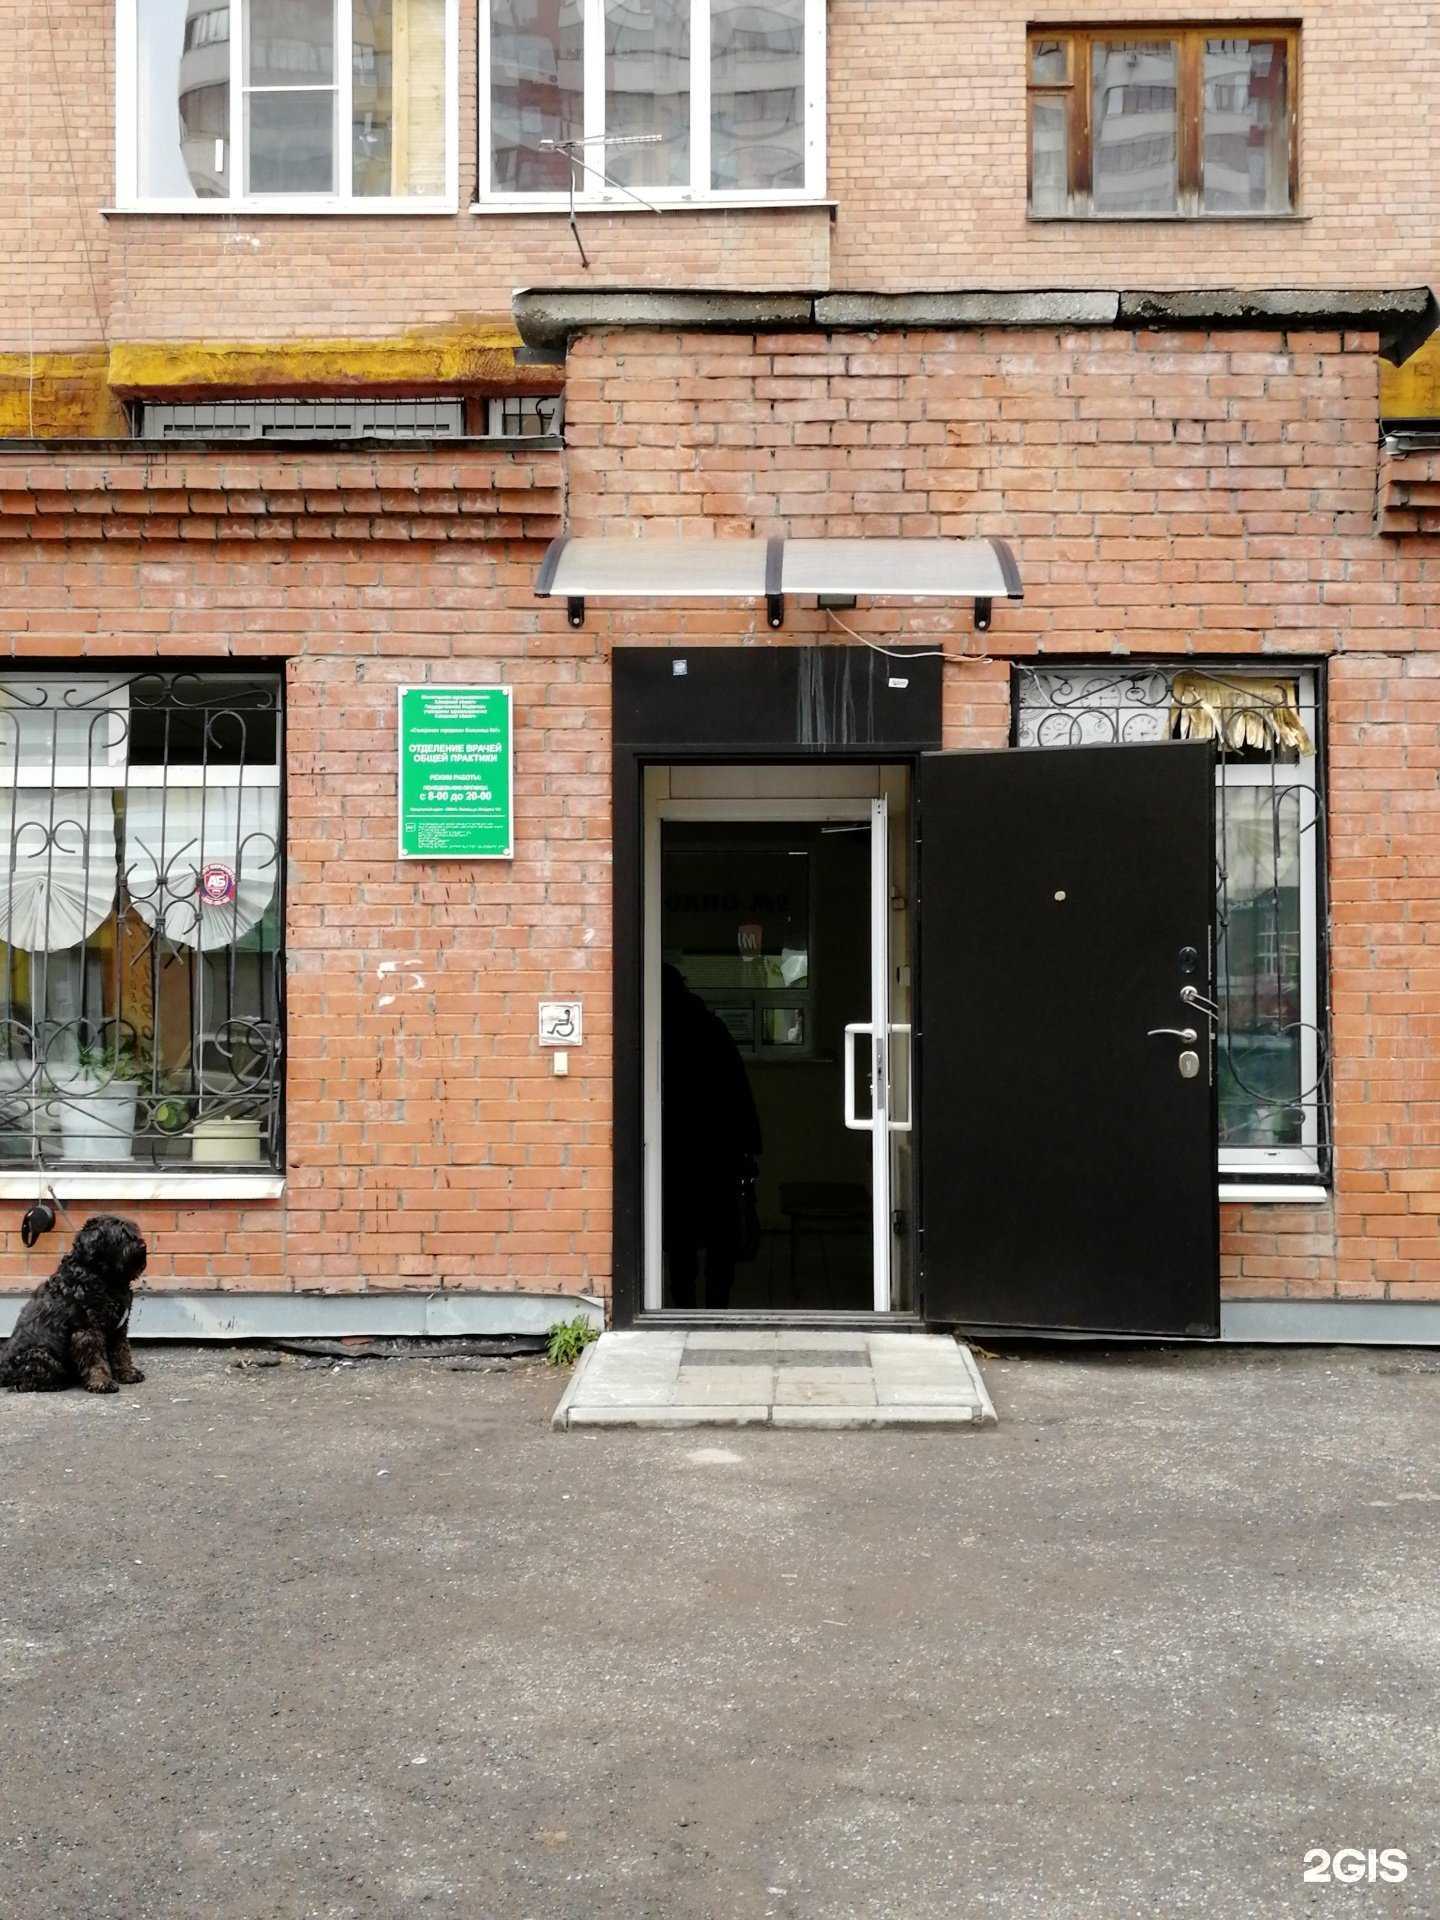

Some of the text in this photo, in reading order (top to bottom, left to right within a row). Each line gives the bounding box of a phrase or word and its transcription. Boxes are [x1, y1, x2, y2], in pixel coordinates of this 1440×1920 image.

[408, 742, 502, 754] ОТДЕЛЕНИЕ ВРАЧЕЙ
[413, 753, 498, 763] ОБЩЕЙ ПРАКТИКИ
[427, 791, 449, 801] 8-00
[450, 793, 464, 802] до
[465, 791, 492, 801] 20-00
